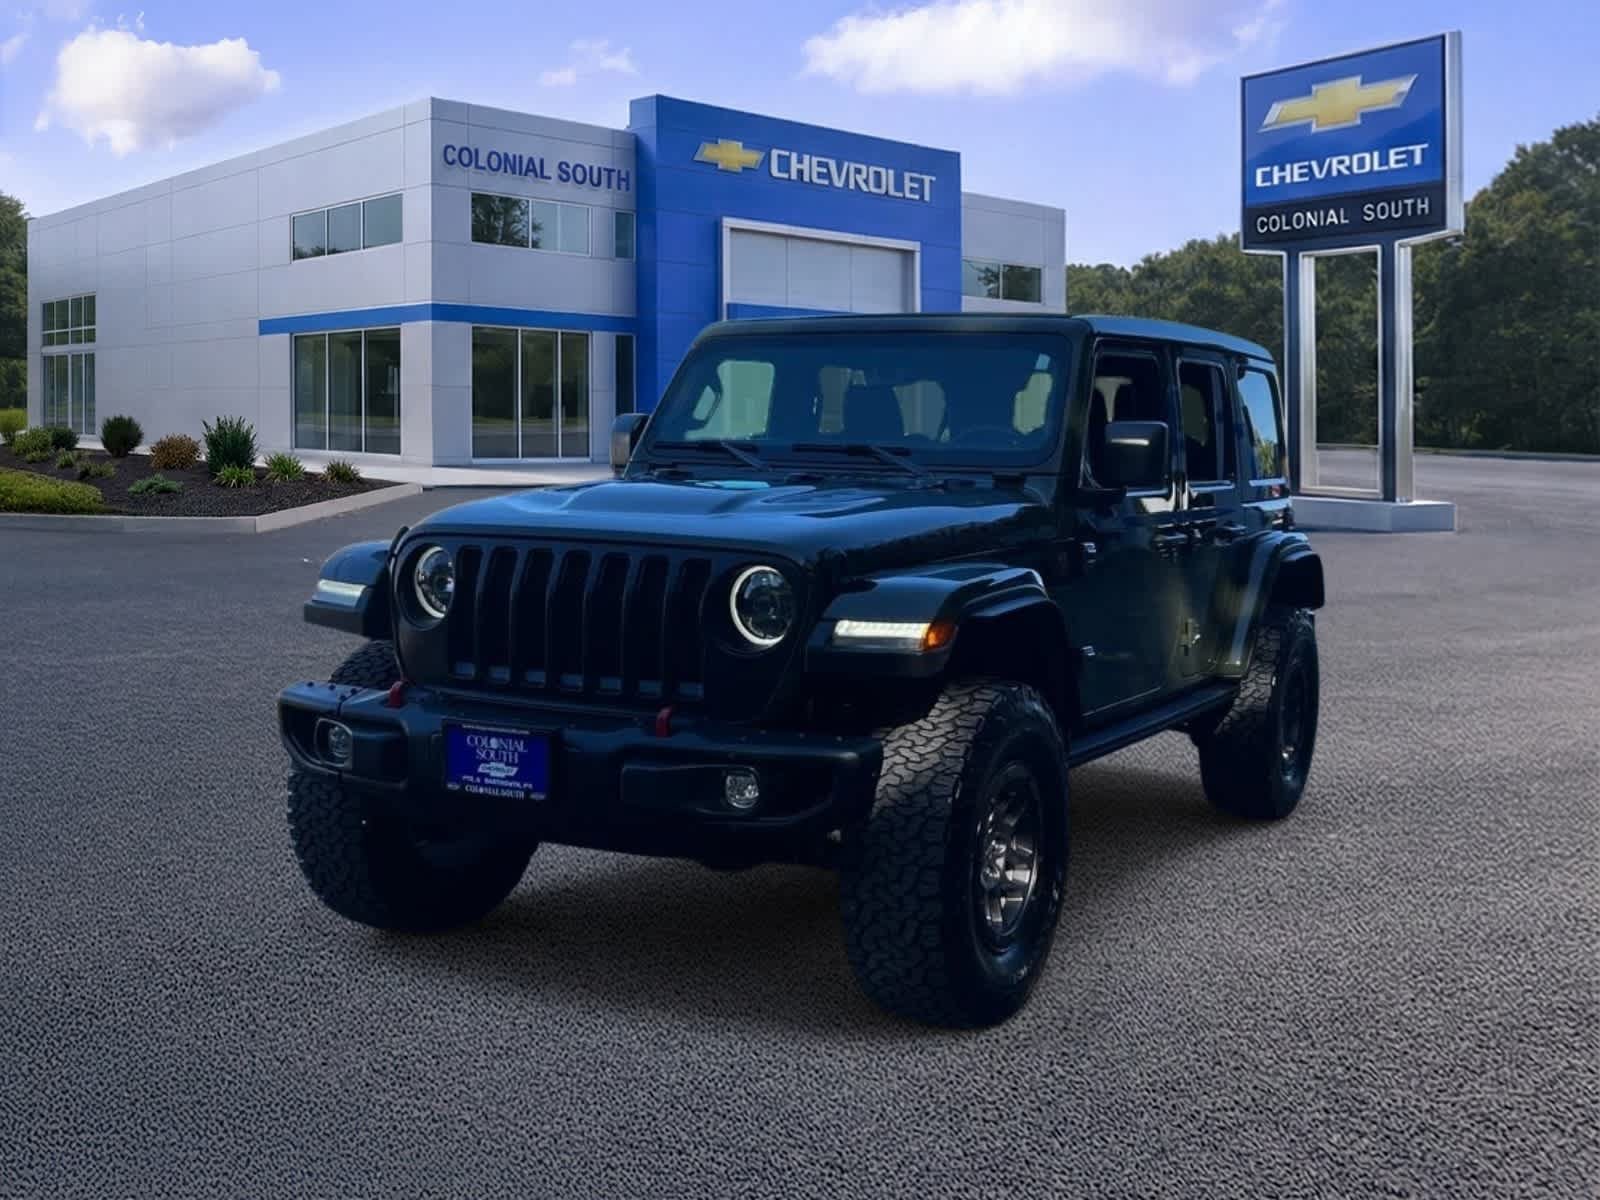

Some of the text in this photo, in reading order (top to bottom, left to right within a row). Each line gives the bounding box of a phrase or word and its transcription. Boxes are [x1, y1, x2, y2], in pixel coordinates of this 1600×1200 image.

[443, 144, 631, 192] COLONIAL SOUTH
[770, 148, 937, 203] CHEVROLET
[1255, 143, 1428, 188] CHEVROLET
[1256, 196, 1430, 234] COLONIAL SOUTH
[466, 734, 528, 753] COLONIAL
[476, 747, 519, 764] SOUTH
